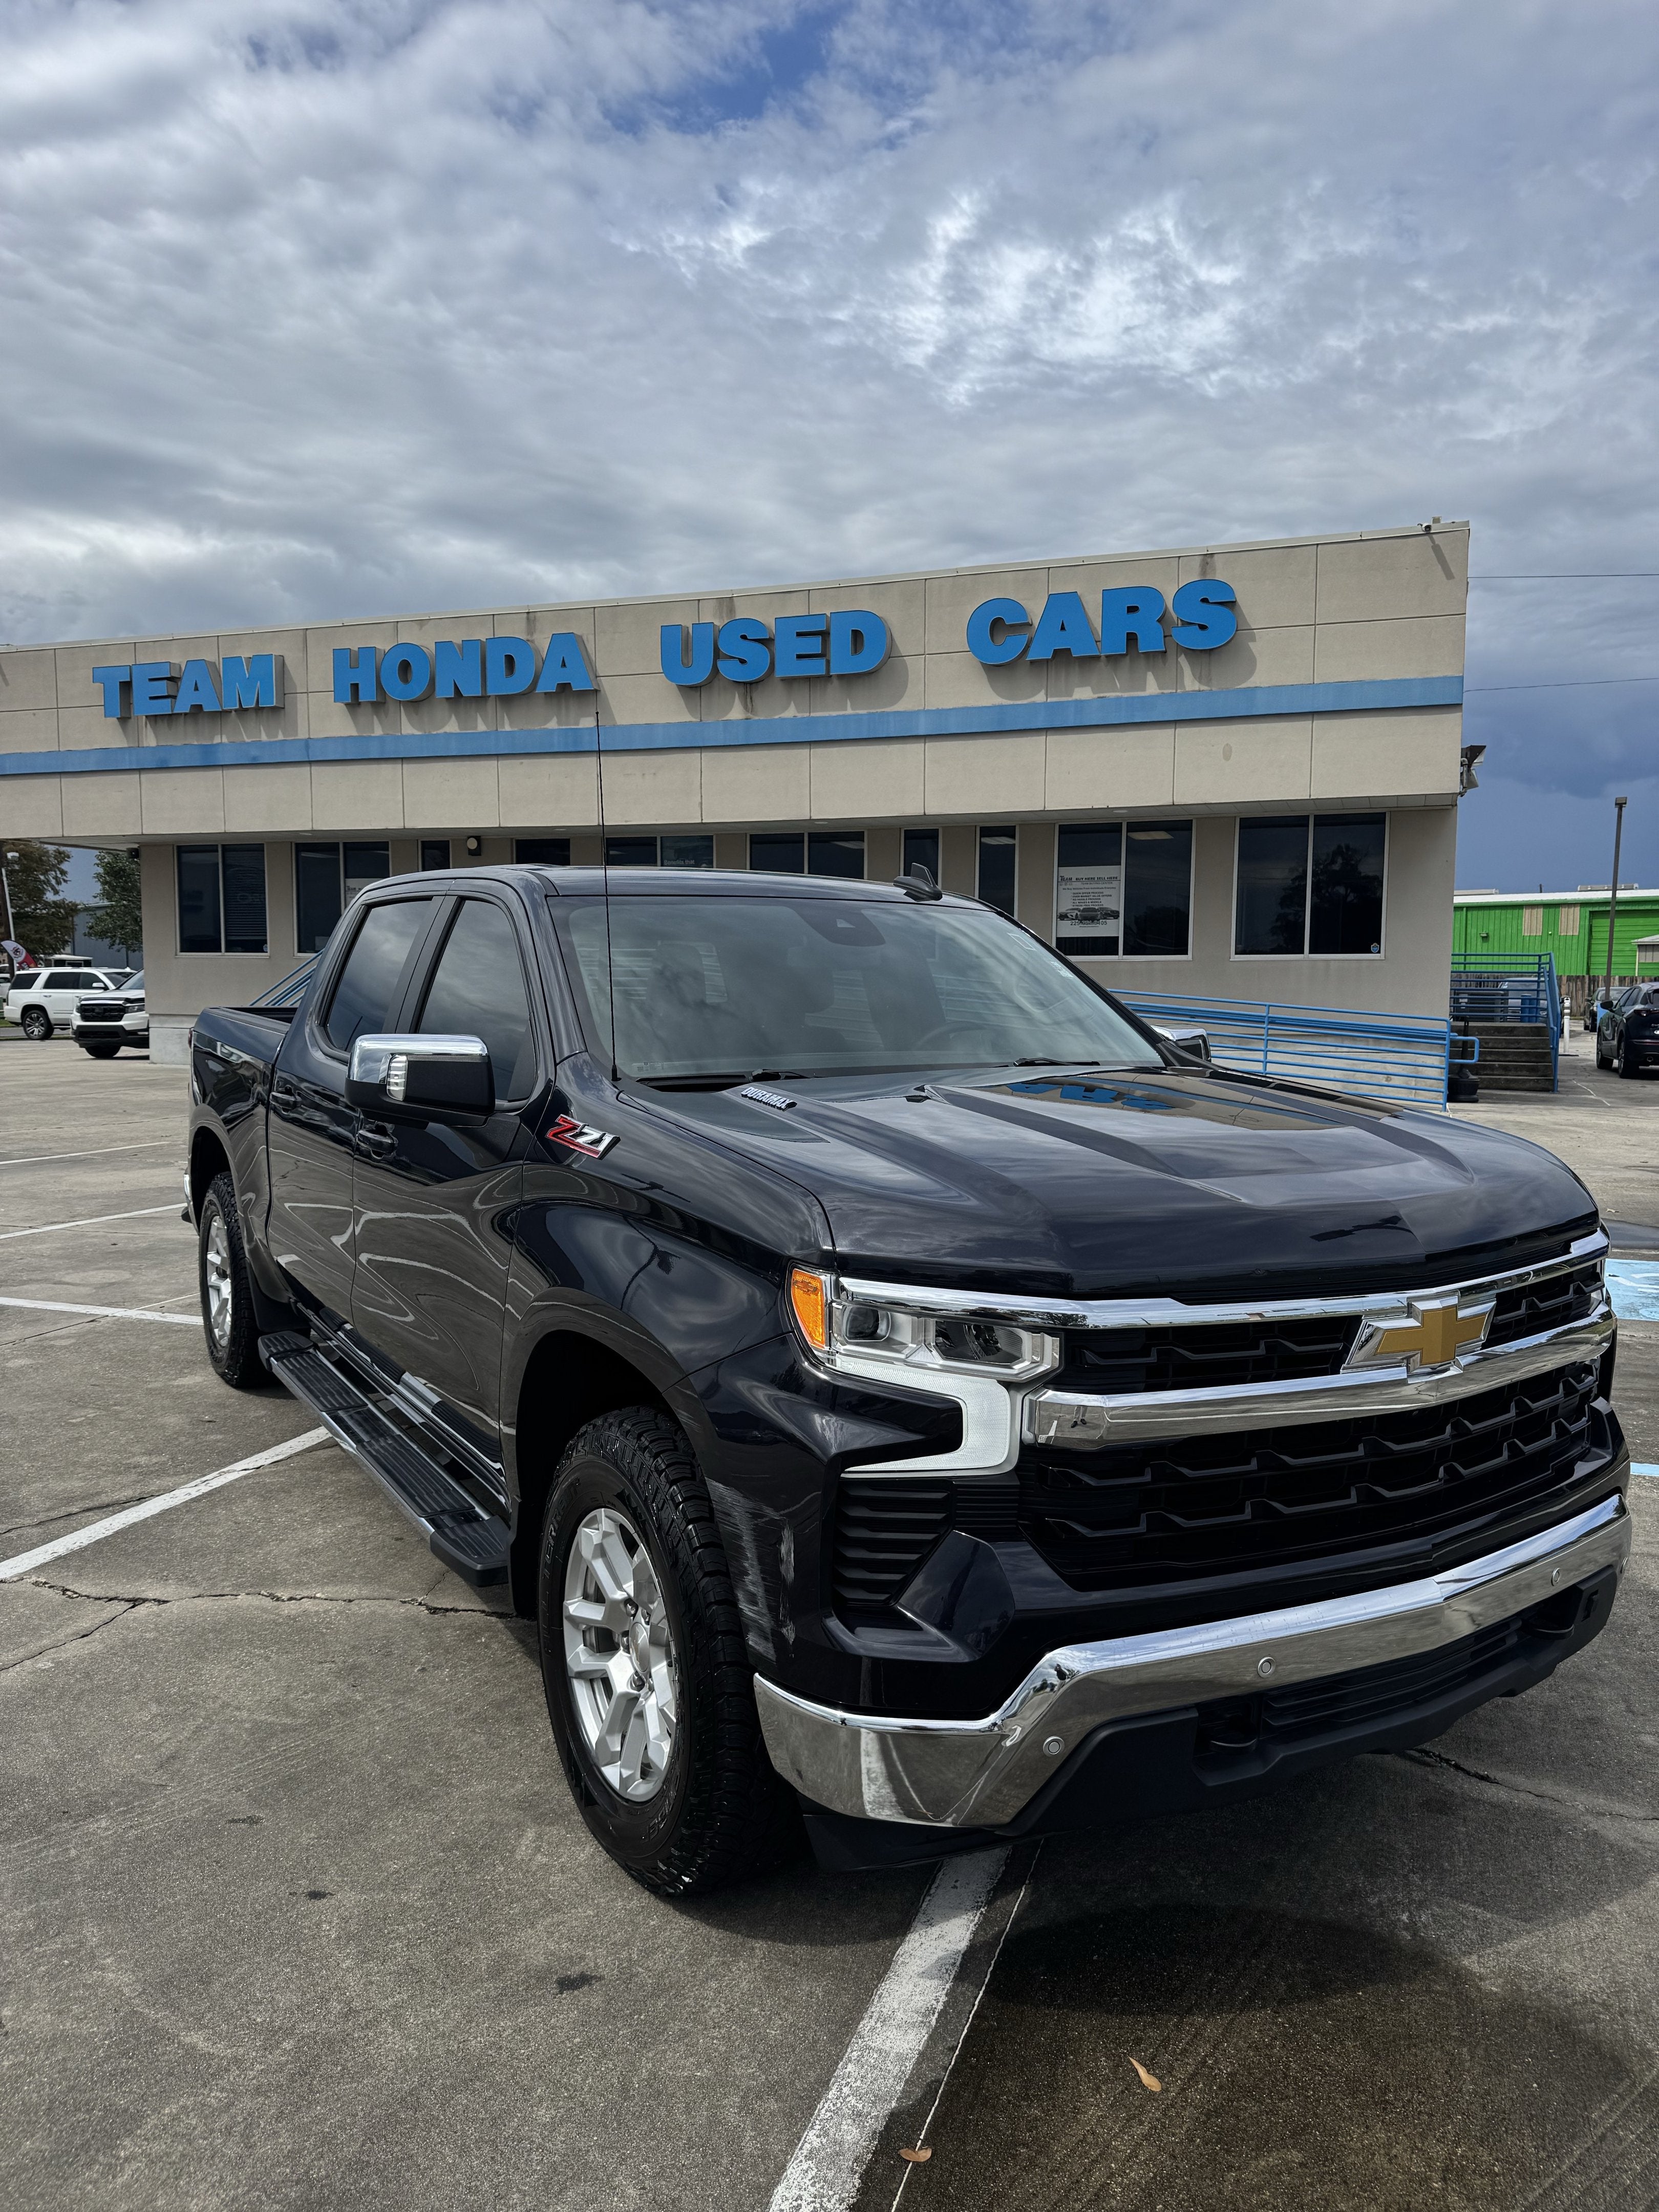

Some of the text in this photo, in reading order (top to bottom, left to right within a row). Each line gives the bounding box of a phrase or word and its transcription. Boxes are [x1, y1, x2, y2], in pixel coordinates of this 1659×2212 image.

[93, 579, 1238, 718] TEAM HONDA USED CARS
[740, 1086, 794, 1111] DURAMAX
[545, 1114, 621, 1160] Z71
